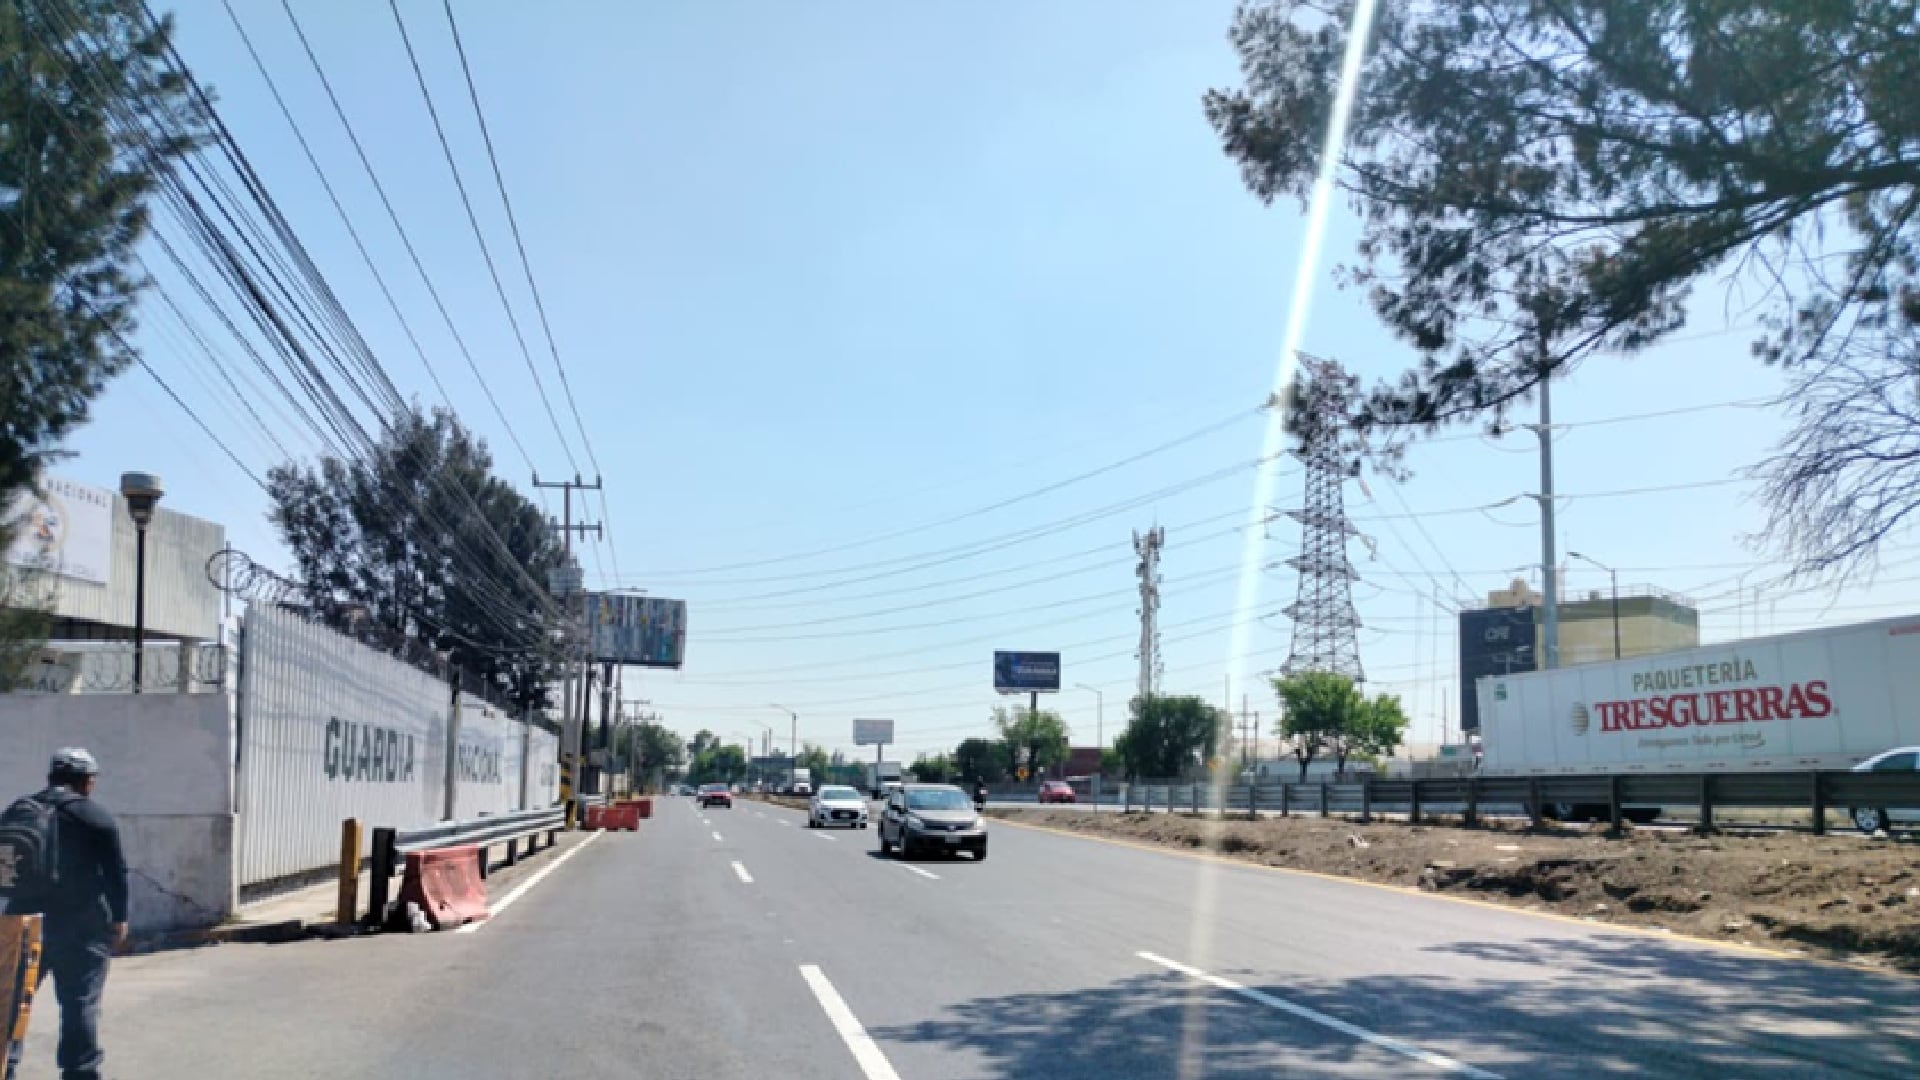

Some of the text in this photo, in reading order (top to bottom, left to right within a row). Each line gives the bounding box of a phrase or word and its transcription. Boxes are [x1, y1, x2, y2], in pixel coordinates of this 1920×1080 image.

[47, 479, 106, 508] NACIONAL
[1595, 680, 1833, 732] TRESGUERRAS
[324, 716, 414, 783] GUARDIA
